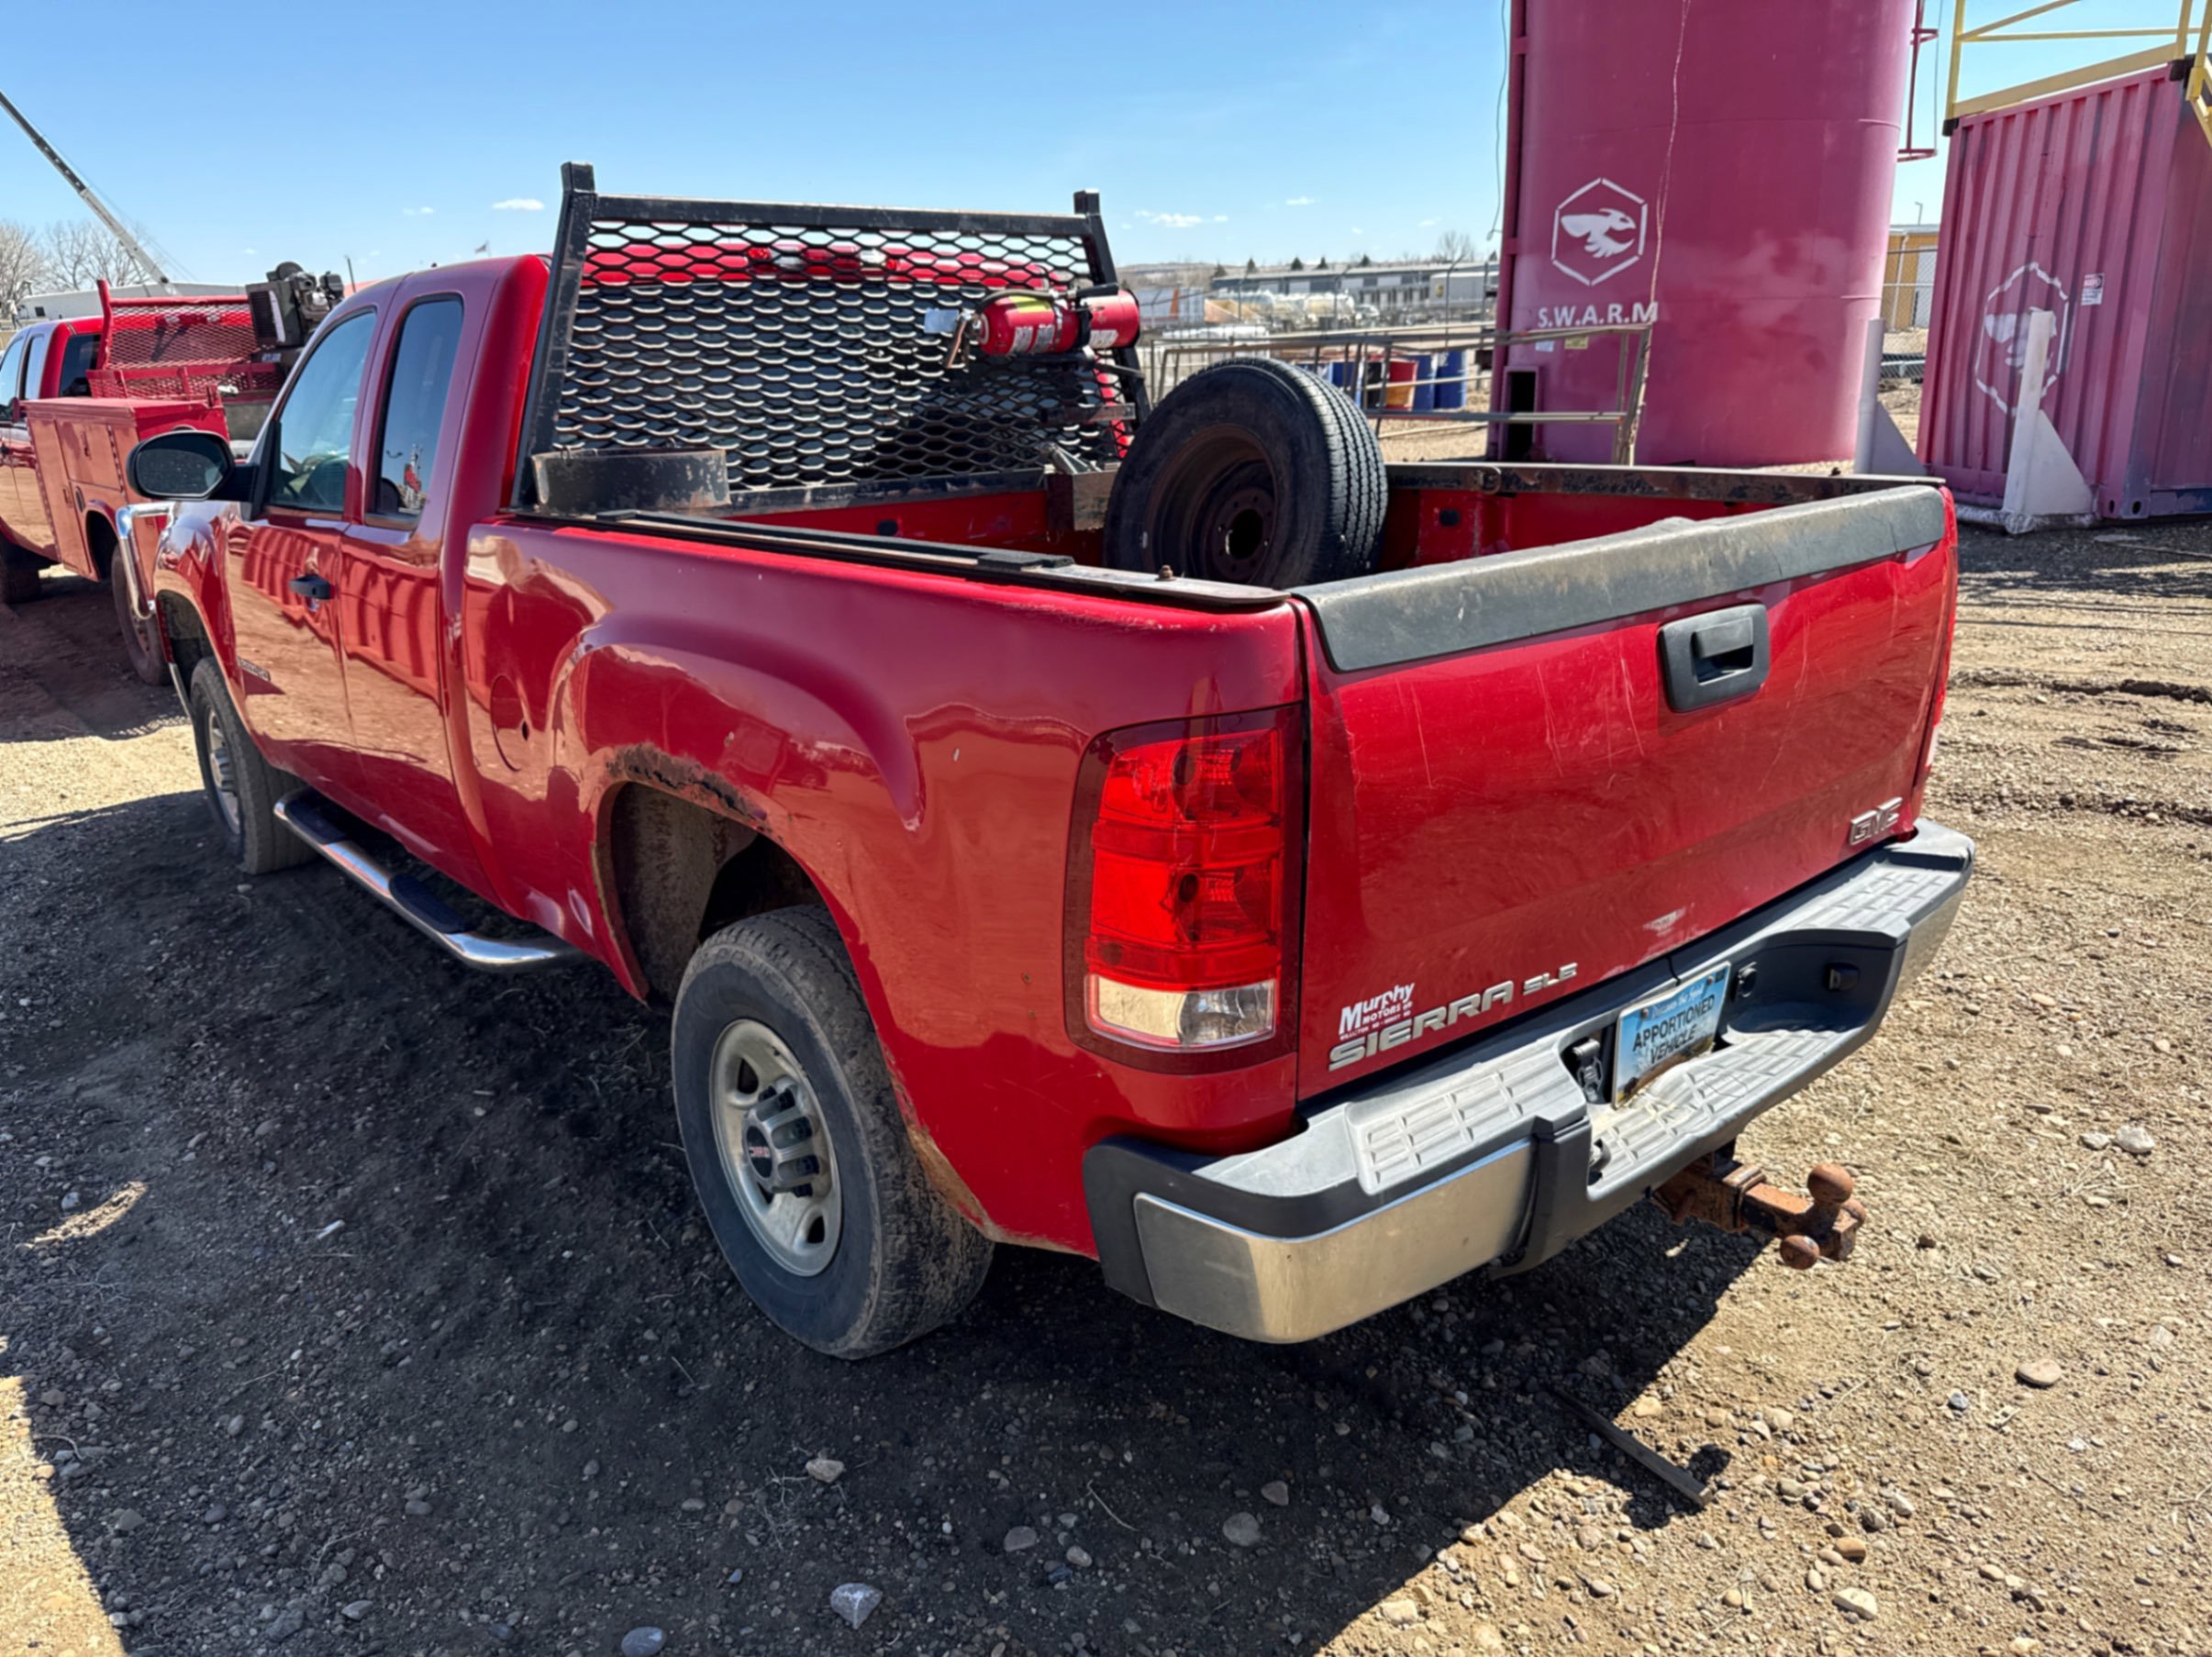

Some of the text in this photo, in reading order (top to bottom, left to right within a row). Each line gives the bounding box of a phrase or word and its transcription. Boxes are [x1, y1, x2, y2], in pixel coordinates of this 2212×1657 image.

[1538, 301, 1658, 328] S.W.A.R.M
[1328, 962, 1578, 1072] SIERRA SLE
[1339, 982, 1416, 1036] Murphy
[1362, 1003, 1401, 1025] MOTORS
[1632, 994, 1715, 1052] APPORTIONED
[1651, 1023, 1696, 1064] VEHICLE
